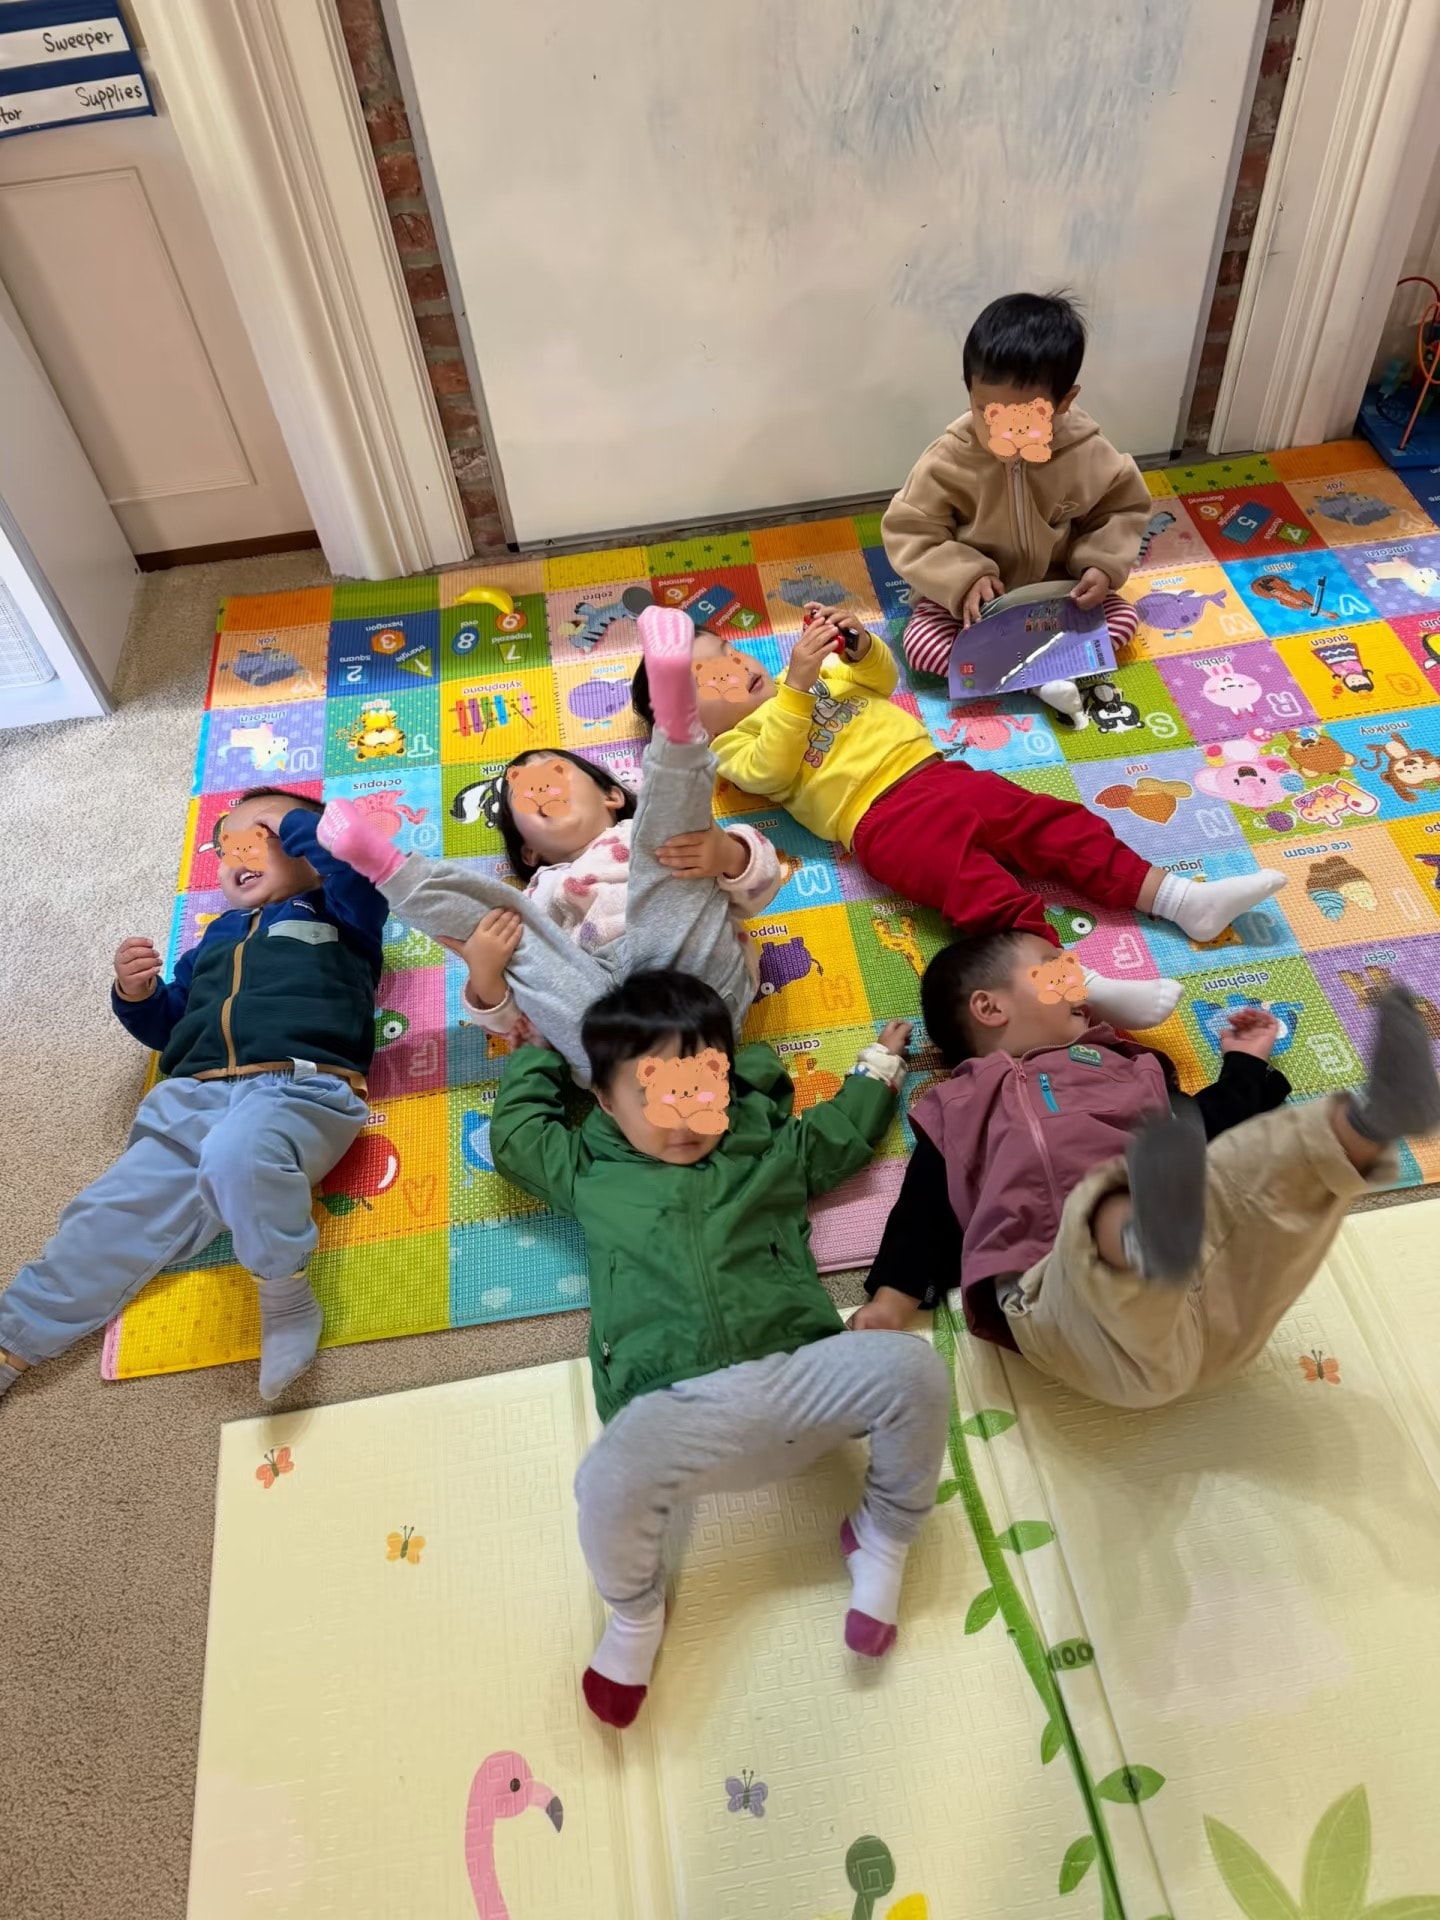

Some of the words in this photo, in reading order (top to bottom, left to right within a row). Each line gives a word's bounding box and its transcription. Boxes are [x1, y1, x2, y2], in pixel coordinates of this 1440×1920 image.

[43, 32, 114, 53] Sweeper
[0, 106, 22, 124] tor
[75, 84, 143, 110] Supplies
[1200, 506, 1220, 518] 6
[1237, 514, 1258, 529] 5
[1288, 528, 1301, 539] 4
[1366, 545, 1414, 557] unicorn
[1263, 561, 1296, 574] violin
[582, 591, 613, 601] zebra
[666, 588, 683, 601] 6
[895, 589, 910, 603] 2
[698, 600, 715, 613] 5
[1339, 594, 1370, 616] V
[365, 620, 404, 633] hexagon
[502, 612, 518, 630] 9
[740, 612, 754, 627] 4
[380, 634, 397, 649] 3
[458, 631, 476, 649] 8
[1310, 634, 1349, 647] queen
[507, 645, 521, 660] 7
[1193, 656, 1231, 668] rabbit
[346, 665, 363, 682] 2
[463, 681, 522, 695] xylophone
[1267, 691, 1300, 717] R
[240, 711, 285, 723] unicorn
[1145, 712, 1178, 739] S
[1360, 721, 1410, 736] monkey
[407, 733, 434, 758] T
[291, 746, 317, 773] U
[482, 764, 508, 774] unk
[1125, 763, 1149, 775] nut
[353, 779, 402, 790] octopus
[1195, 807, 1236, 840] N
[1283, 843, 1327, 860] cream
[1329, 840, 1354, 855] ice
[1162, 859, 1204, 873] jagua
[796, 865, 832, 896] M
[874, 901, 920, 915] iraffe
[750, 924, 788, 939] hippo
[1363, 949, 1397, 964] deer
[1202, 971, 1269, 992] elephant
[777, 1038, 821, 1054] camel
[402, 1174, 438, 1217] A
